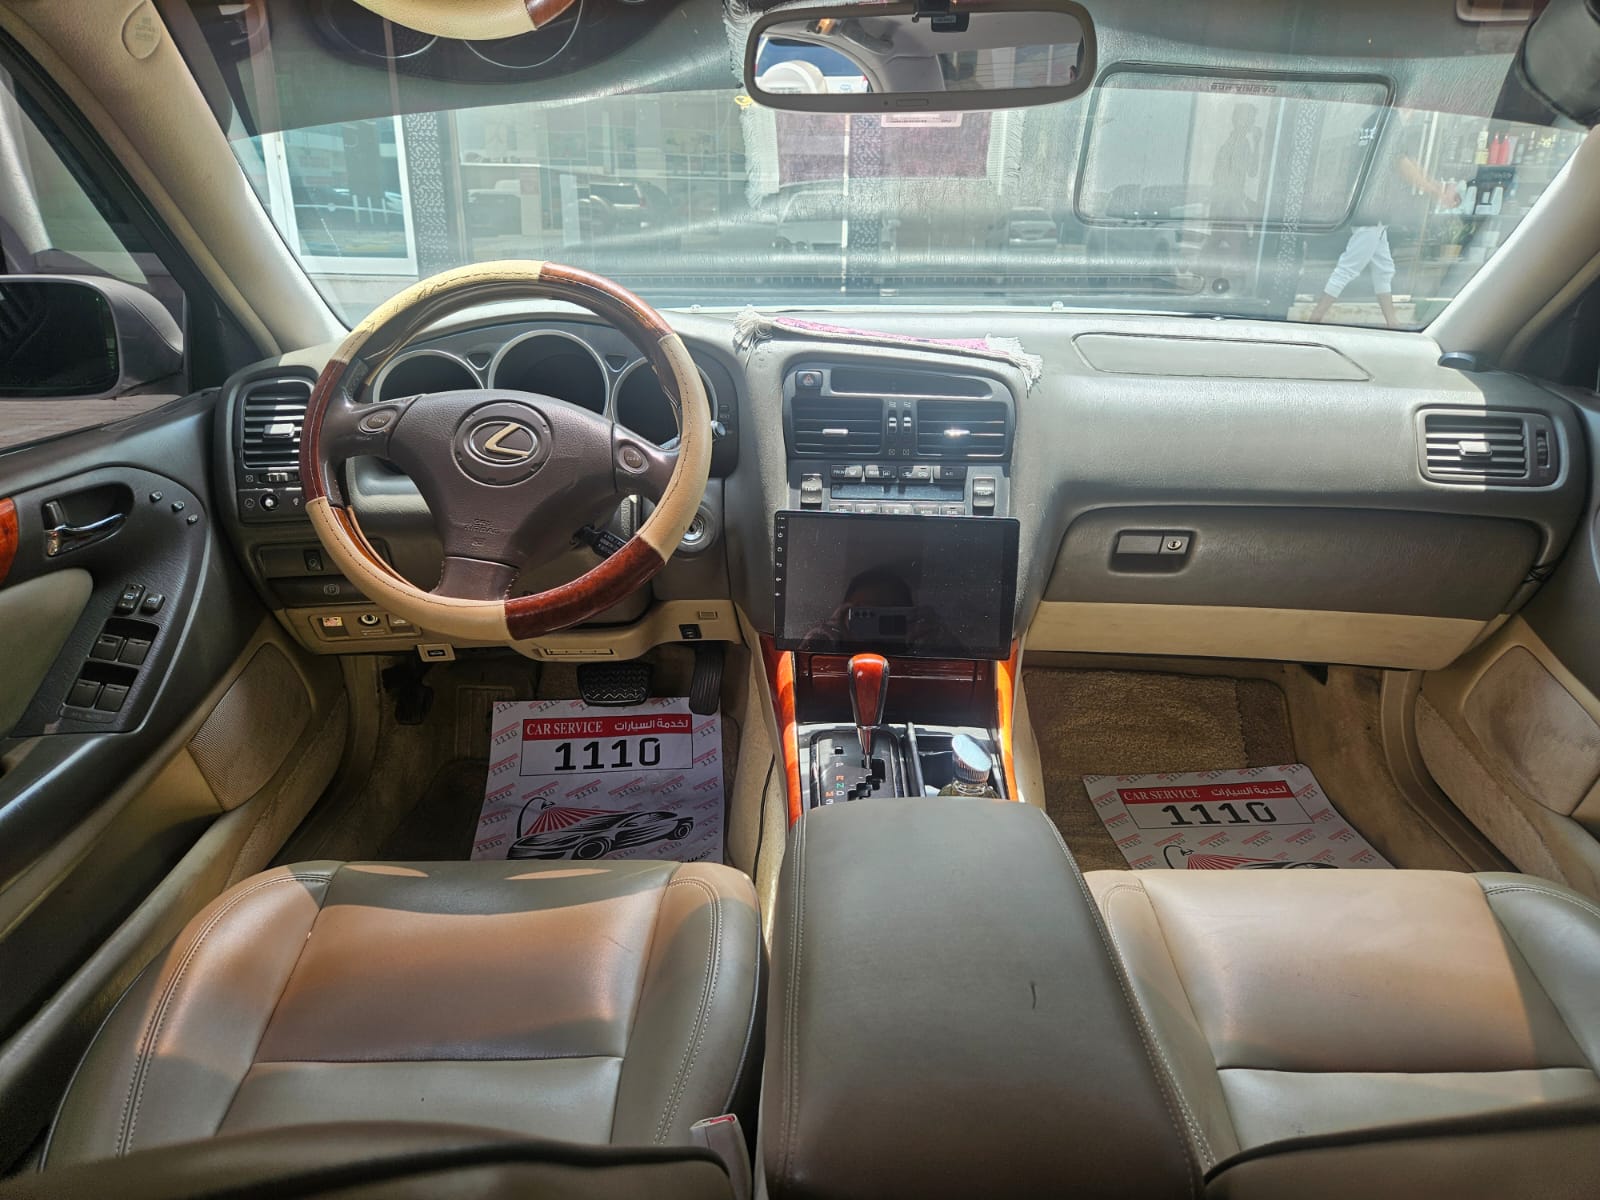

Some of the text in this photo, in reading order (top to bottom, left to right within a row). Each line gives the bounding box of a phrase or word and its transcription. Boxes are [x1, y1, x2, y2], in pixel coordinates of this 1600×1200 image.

[526, 720, 603, 736] CAR SERVICE
[614, 718, 689, 732] لخدمة السيارات
[554, 737, 661, 771] 1110
[1123, 788, 1200, 801] CAR SERVICE
[1162, 801, 1277, 825] 1110
